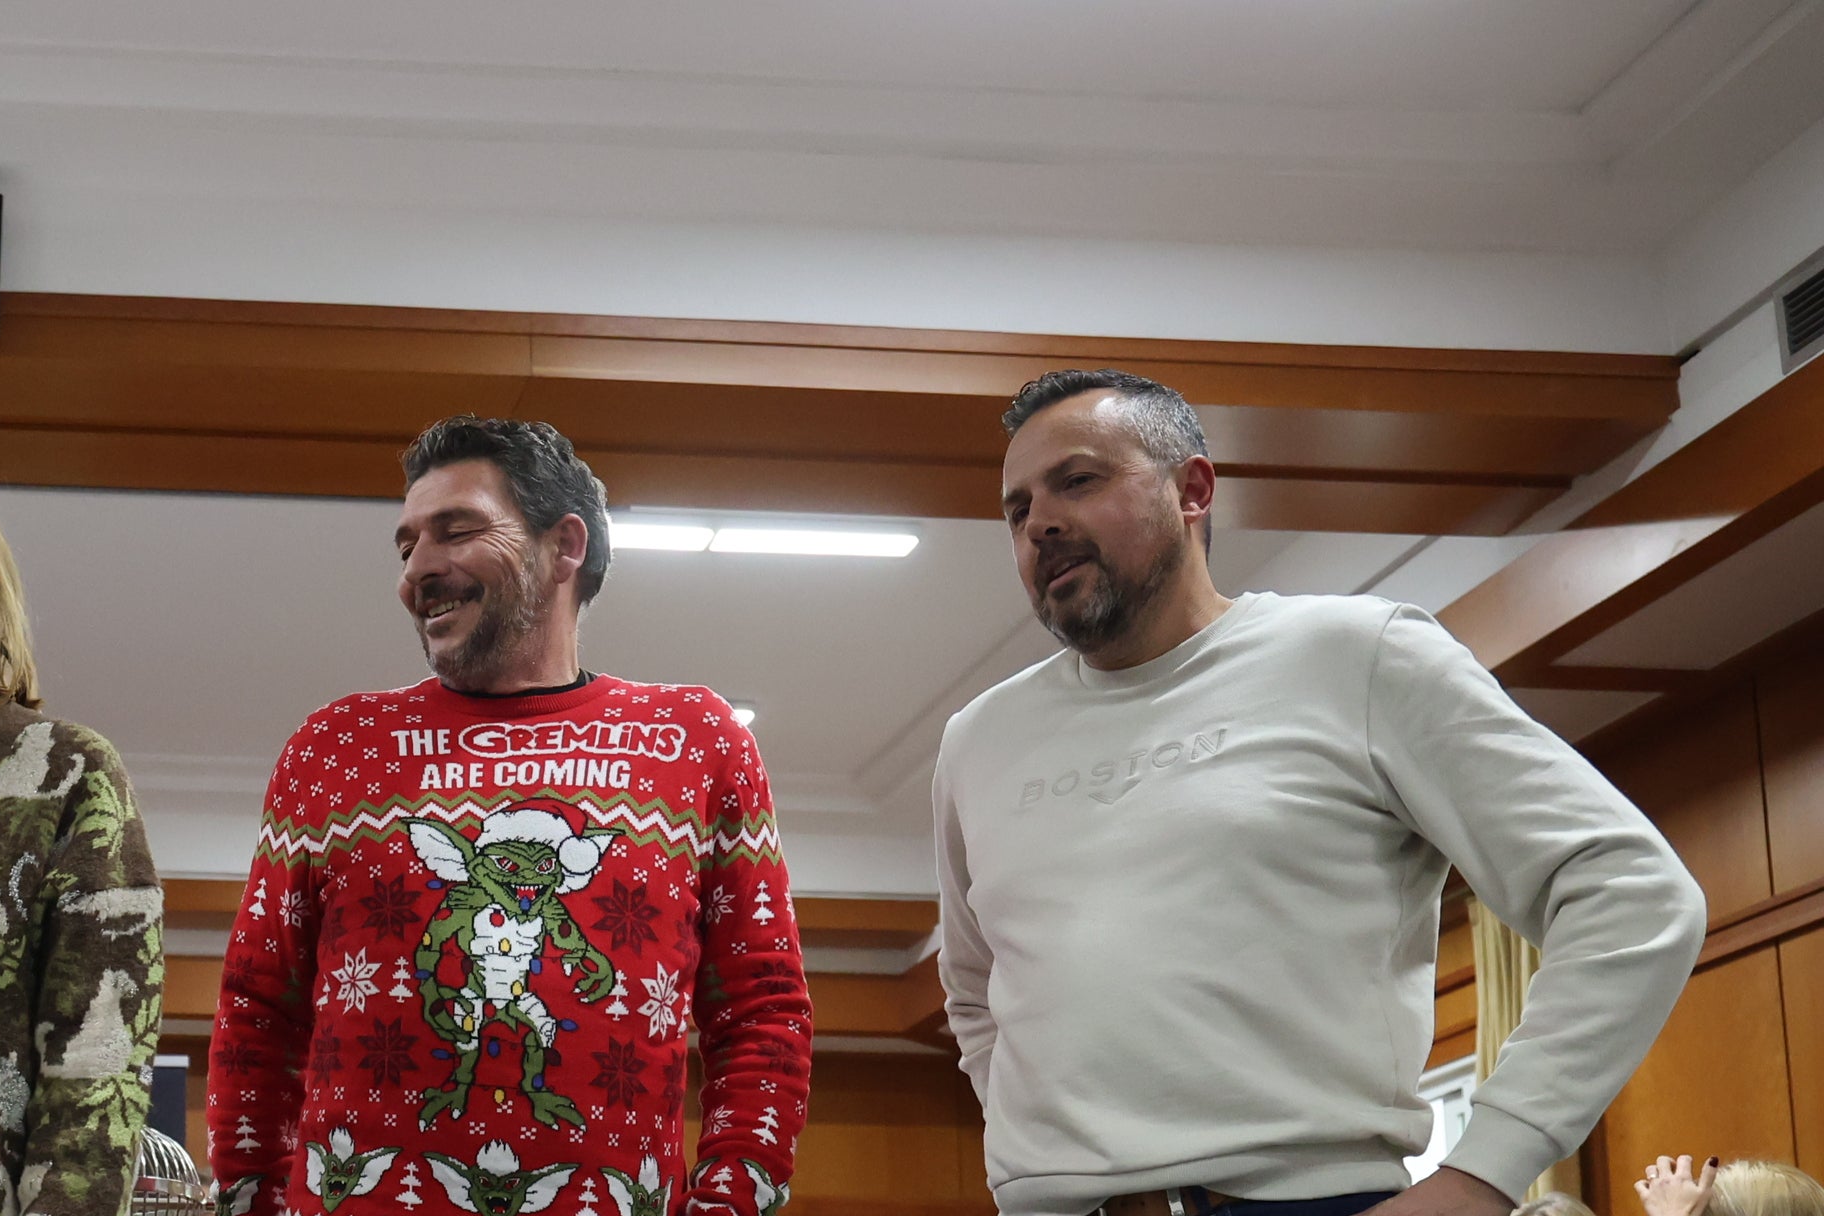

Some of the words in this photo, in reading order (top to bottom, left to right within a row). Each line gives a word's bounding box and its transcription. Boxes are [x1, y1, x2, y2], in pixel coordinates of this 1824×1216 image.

[390, 729, 451, 757] THE
[419, 762, 484, 790] ARE
[493, 759, 632, 789] COMING
[1019, 727, 1228, 807] BOSTON
